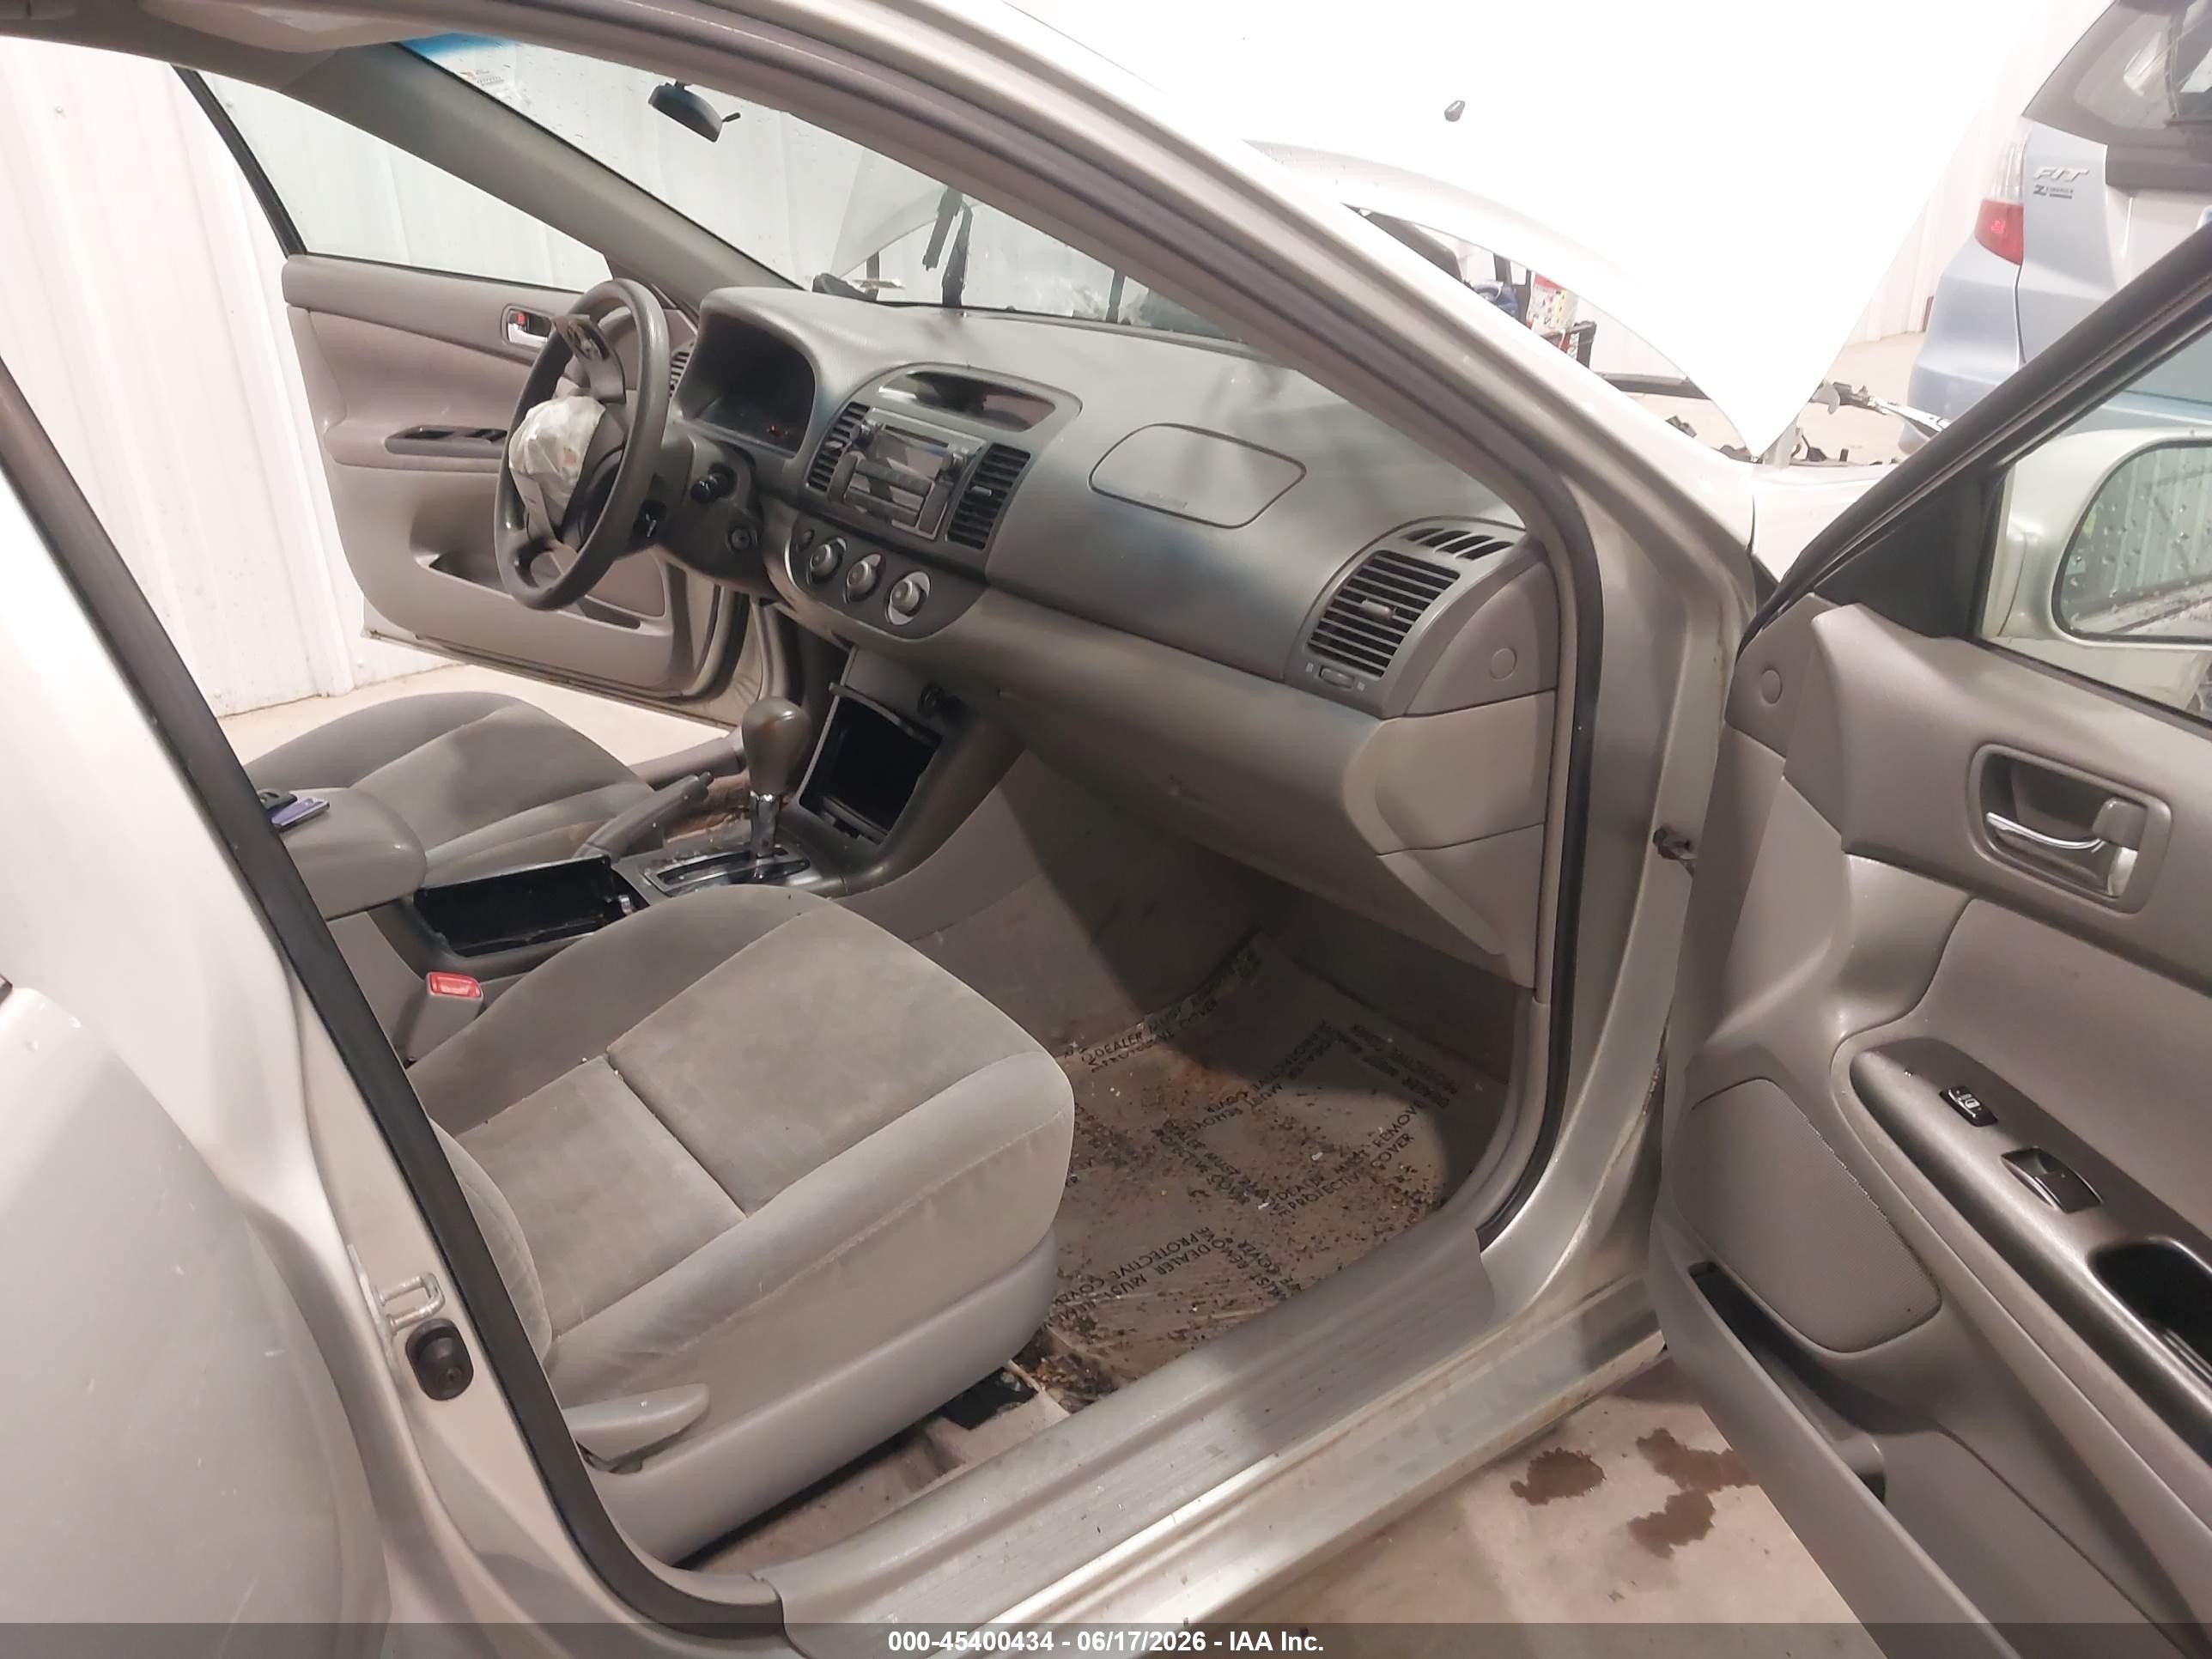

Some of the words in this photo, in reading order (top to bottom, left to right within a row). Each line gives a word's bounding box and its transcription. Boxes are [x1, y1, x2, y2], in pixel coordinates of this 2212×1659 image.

[2033, 167, 2088, 182] FIT
[1094, 1030, 1144, 1057] DEALER
[1371, 1132, 1415, 1171] COVER
[1109, 1231, 1202, 1280] PROTECTIVE
[1153, 1243, 1212, 1275] DEALER
[1103, 1273, 1147, 1298] MUST
